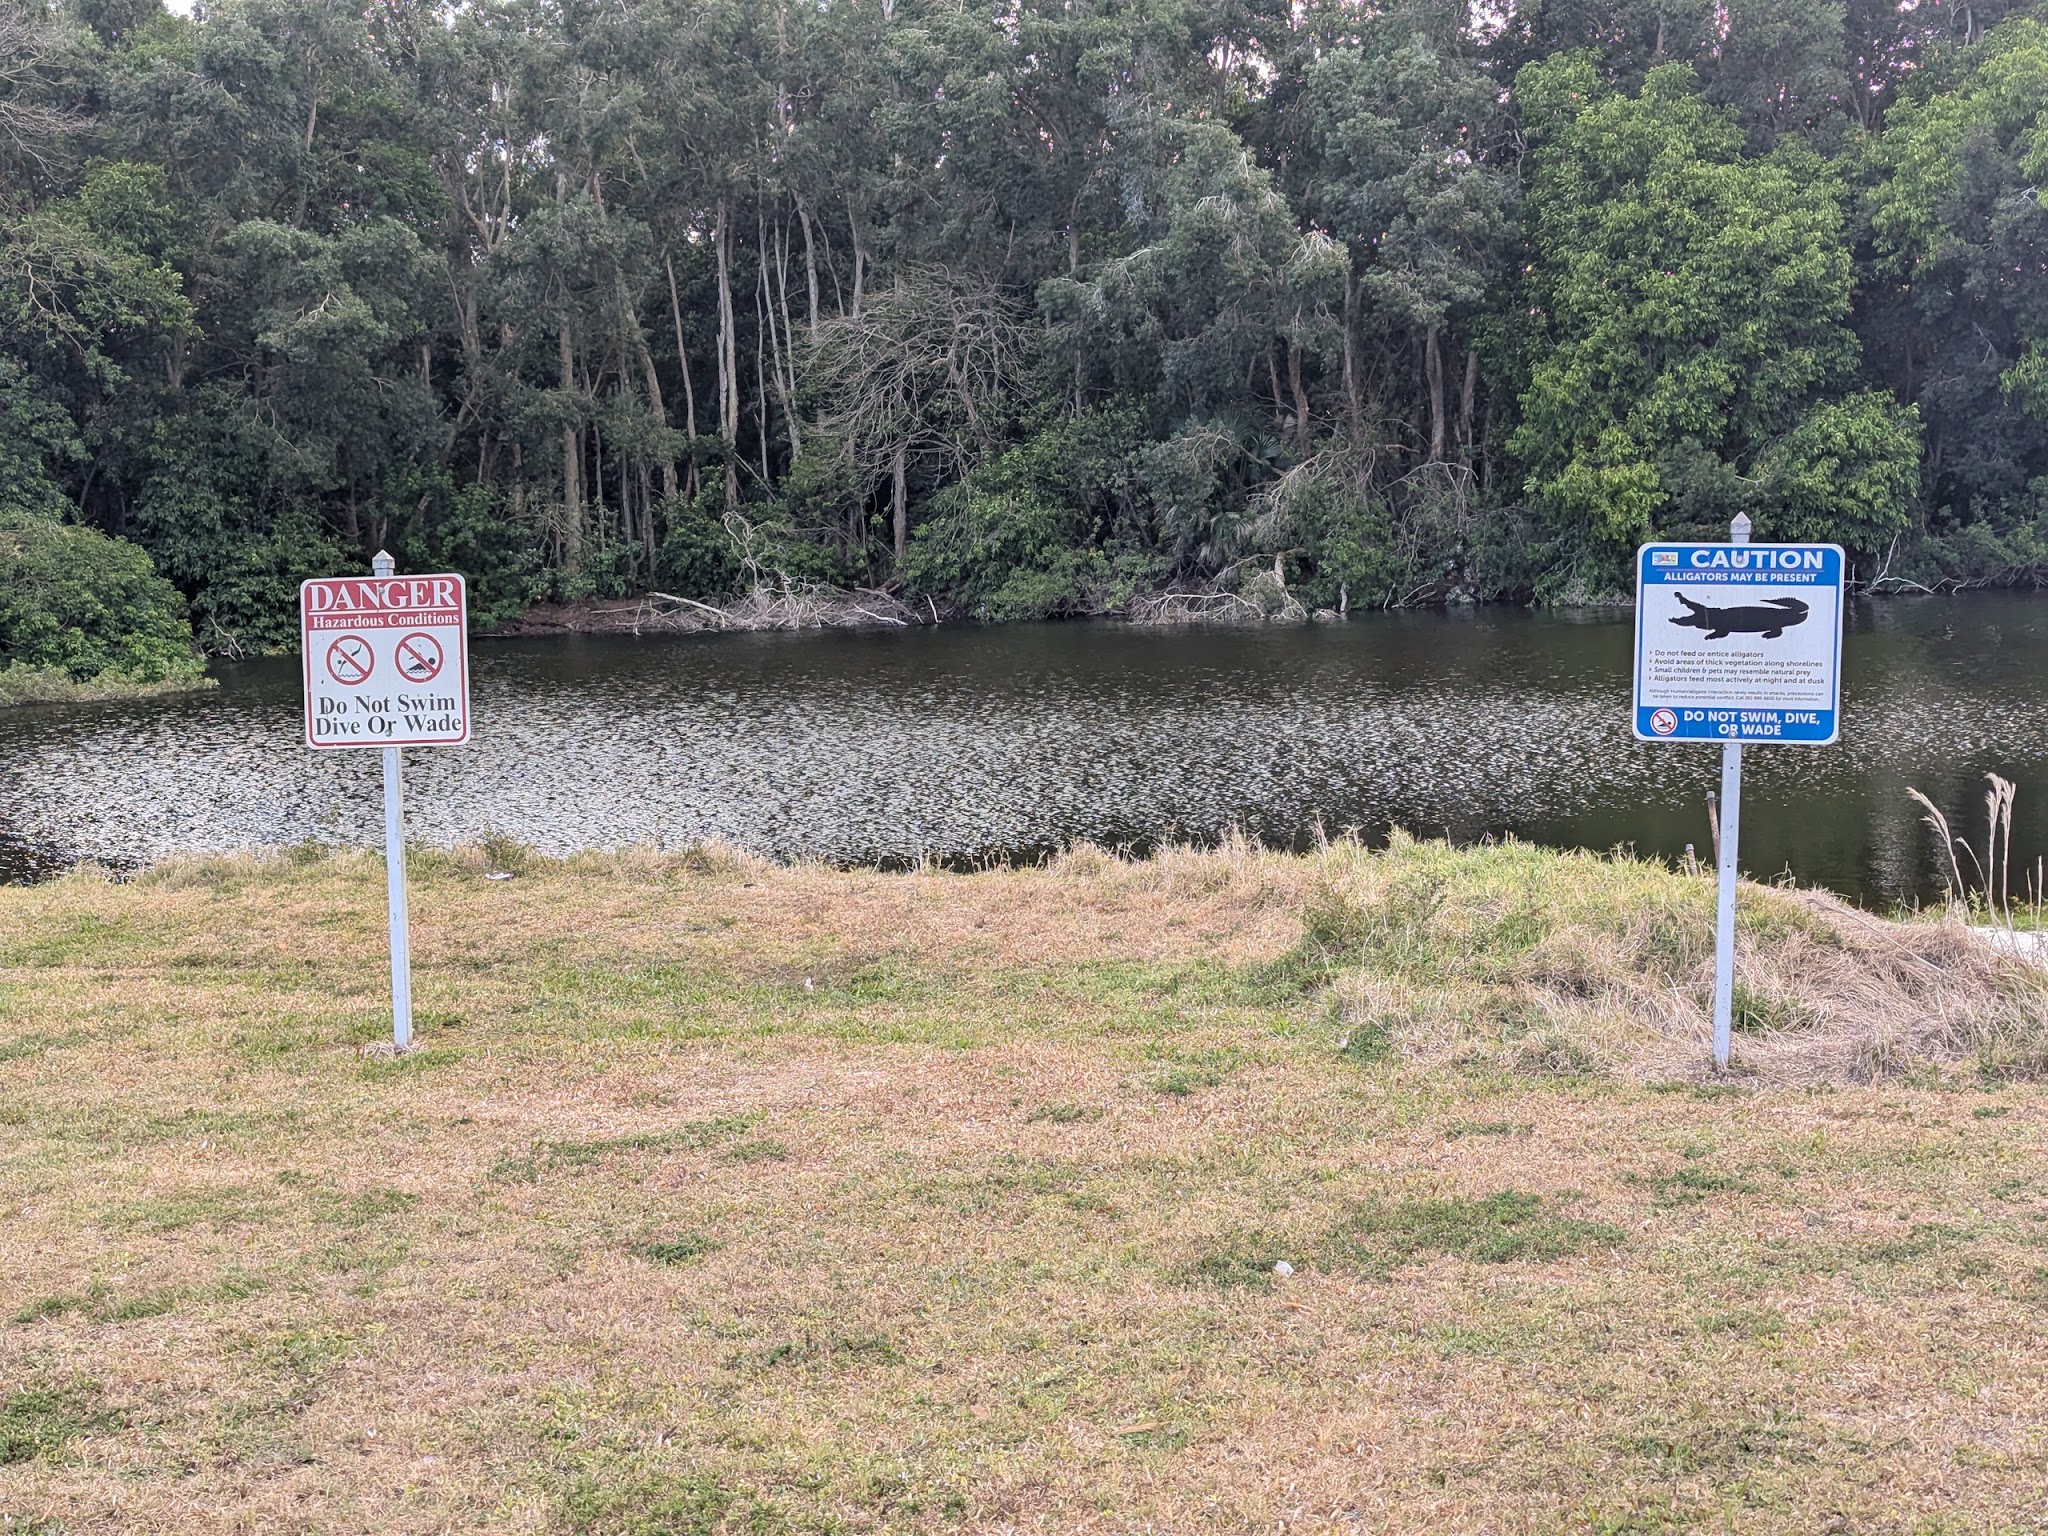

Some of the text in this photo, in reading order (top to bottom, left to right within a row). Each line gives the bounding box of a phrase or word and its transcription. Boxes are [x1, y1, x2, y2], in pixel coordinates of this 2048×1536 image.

[1690, 550, 1824, 570] CAUTION
[1664, 572, 1817, 583] ALLIGATORS MAY BE PRESENT
[308, 580, 457, 610] DANGER
[313, 612, 460, 628] Hazardous Conditions
[1730, 651, 1764, 659] alligators
[319, 693, 456, 715] Do Not Swim
[315, 714, 462, 736] Dive Or Wade
[1684, 711, 1821, 725] DO NOT SWIM, DIVE,
[1718, 724, 1782, 736] OR WADE
